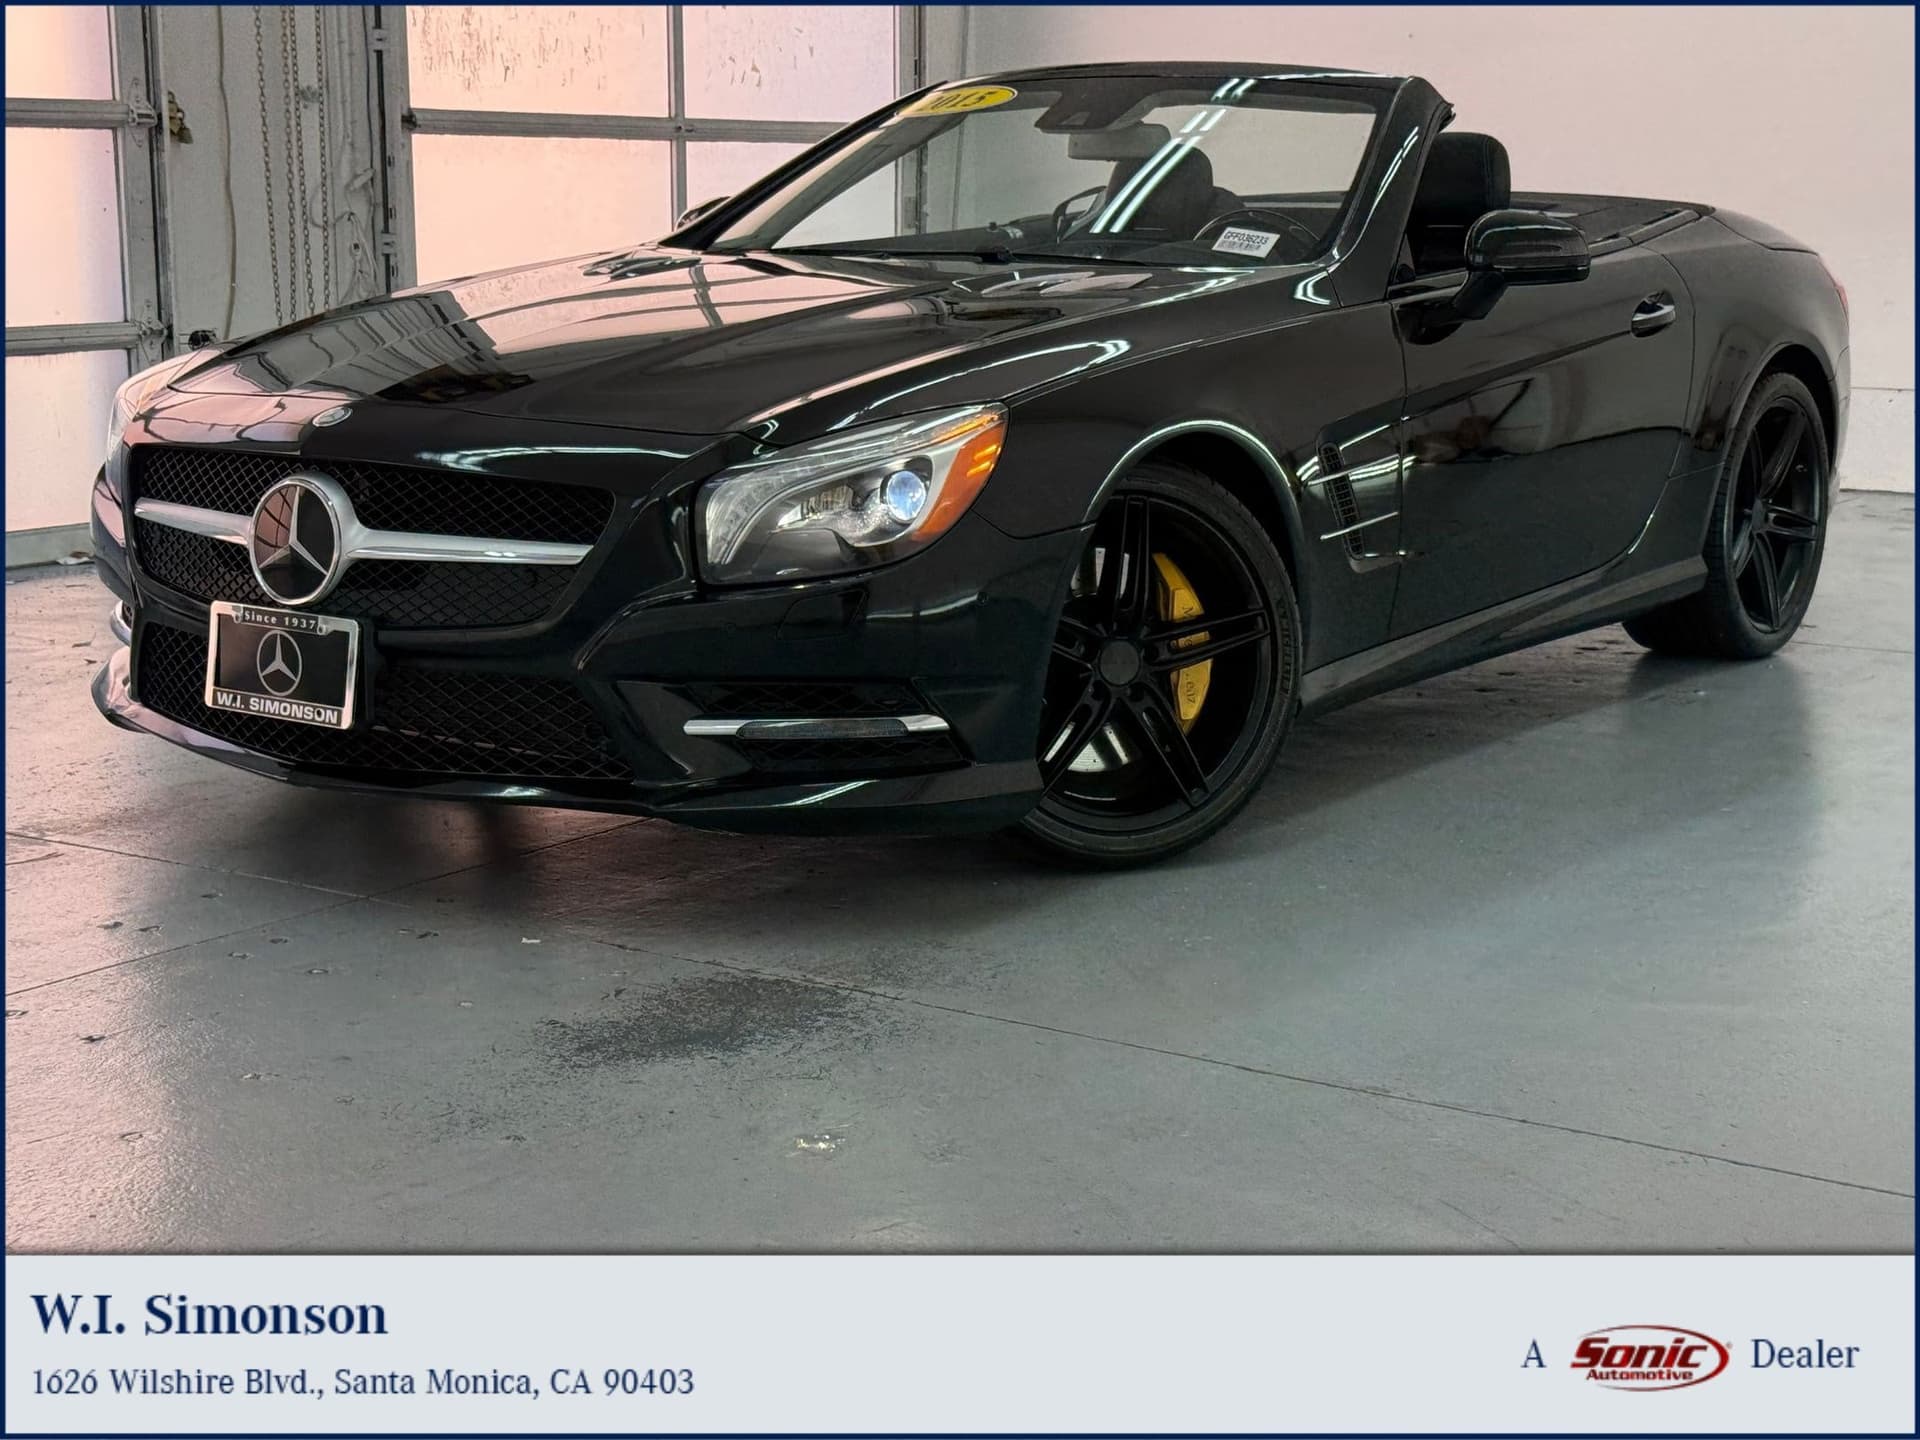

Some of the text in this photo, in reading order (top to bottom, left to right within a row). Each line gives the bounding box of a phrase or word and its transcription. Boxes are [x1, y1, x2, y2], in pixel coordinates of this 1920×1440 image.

[244, 612, 316, 630] Since 1937
[216, 691, 338, 724] W.I. SIMONSON
